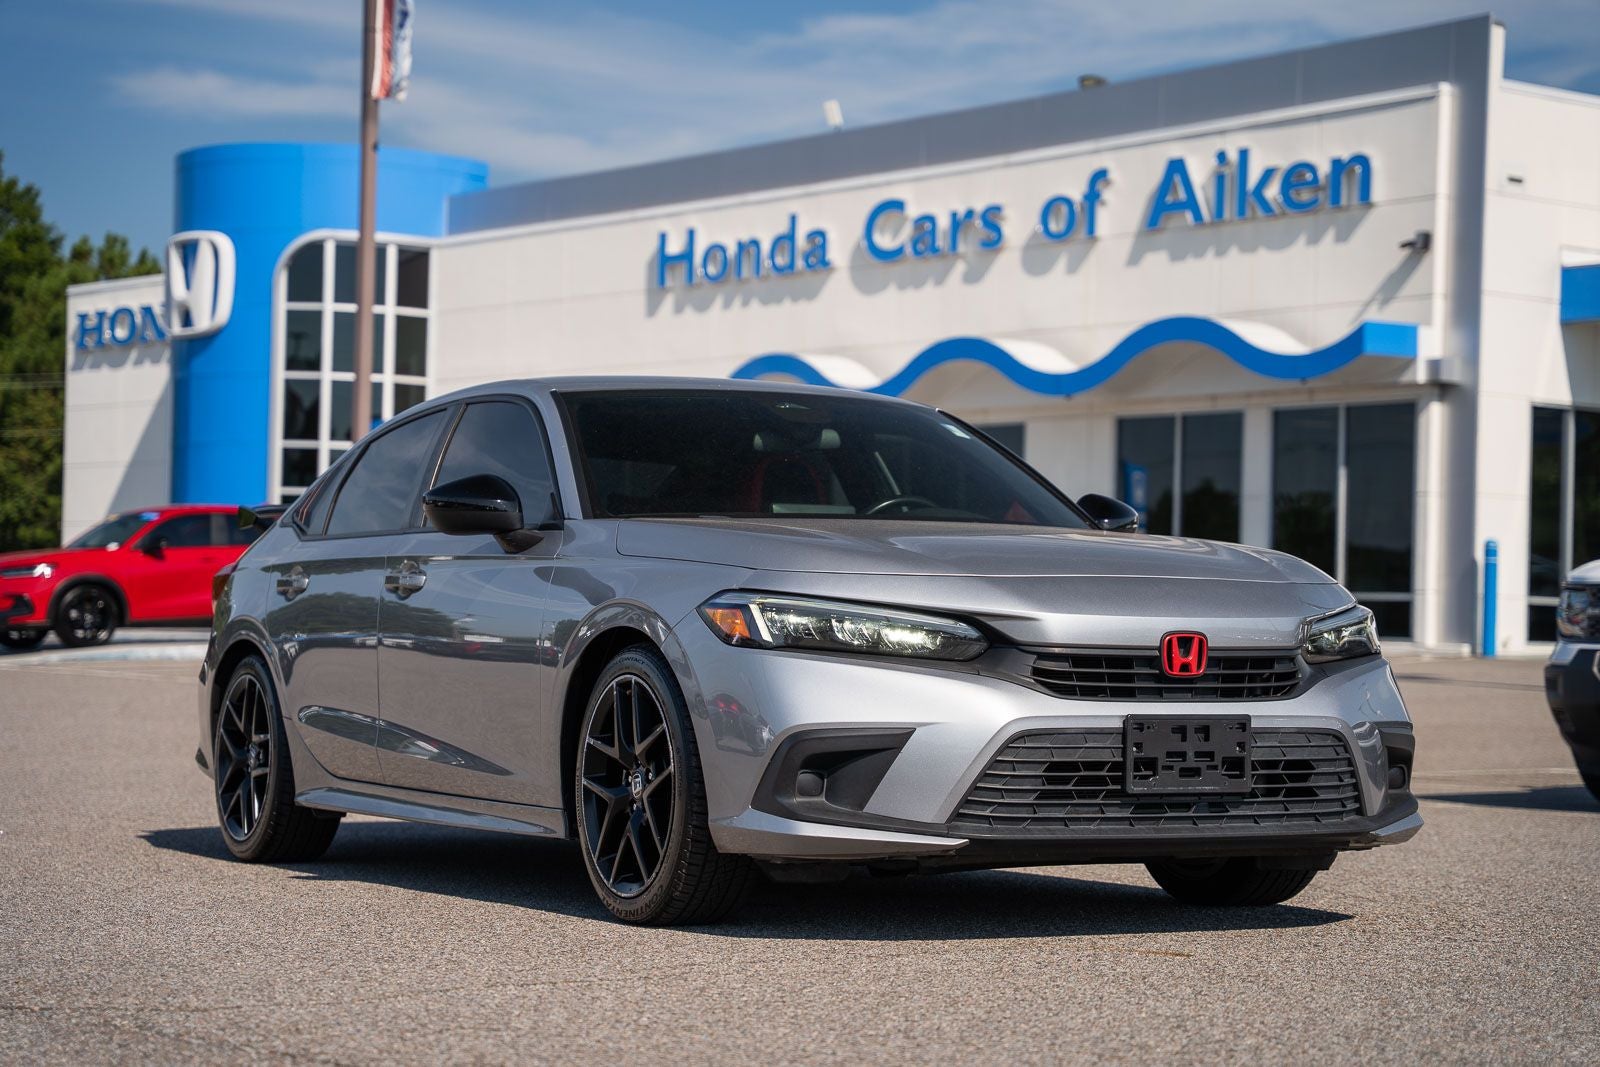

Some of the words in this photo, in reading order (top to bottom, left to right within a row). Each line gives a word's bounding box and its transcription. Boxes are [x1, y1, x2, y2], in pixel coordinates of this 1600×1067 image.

[657, 213, 832, 290] Honda
[864, 198, 1005, 264] Cars
[1040, 168, 1110, 243] of
[1146, 147, 1374, 232] Aiken
[601, 884, 664, 919] CONTINENTAL
